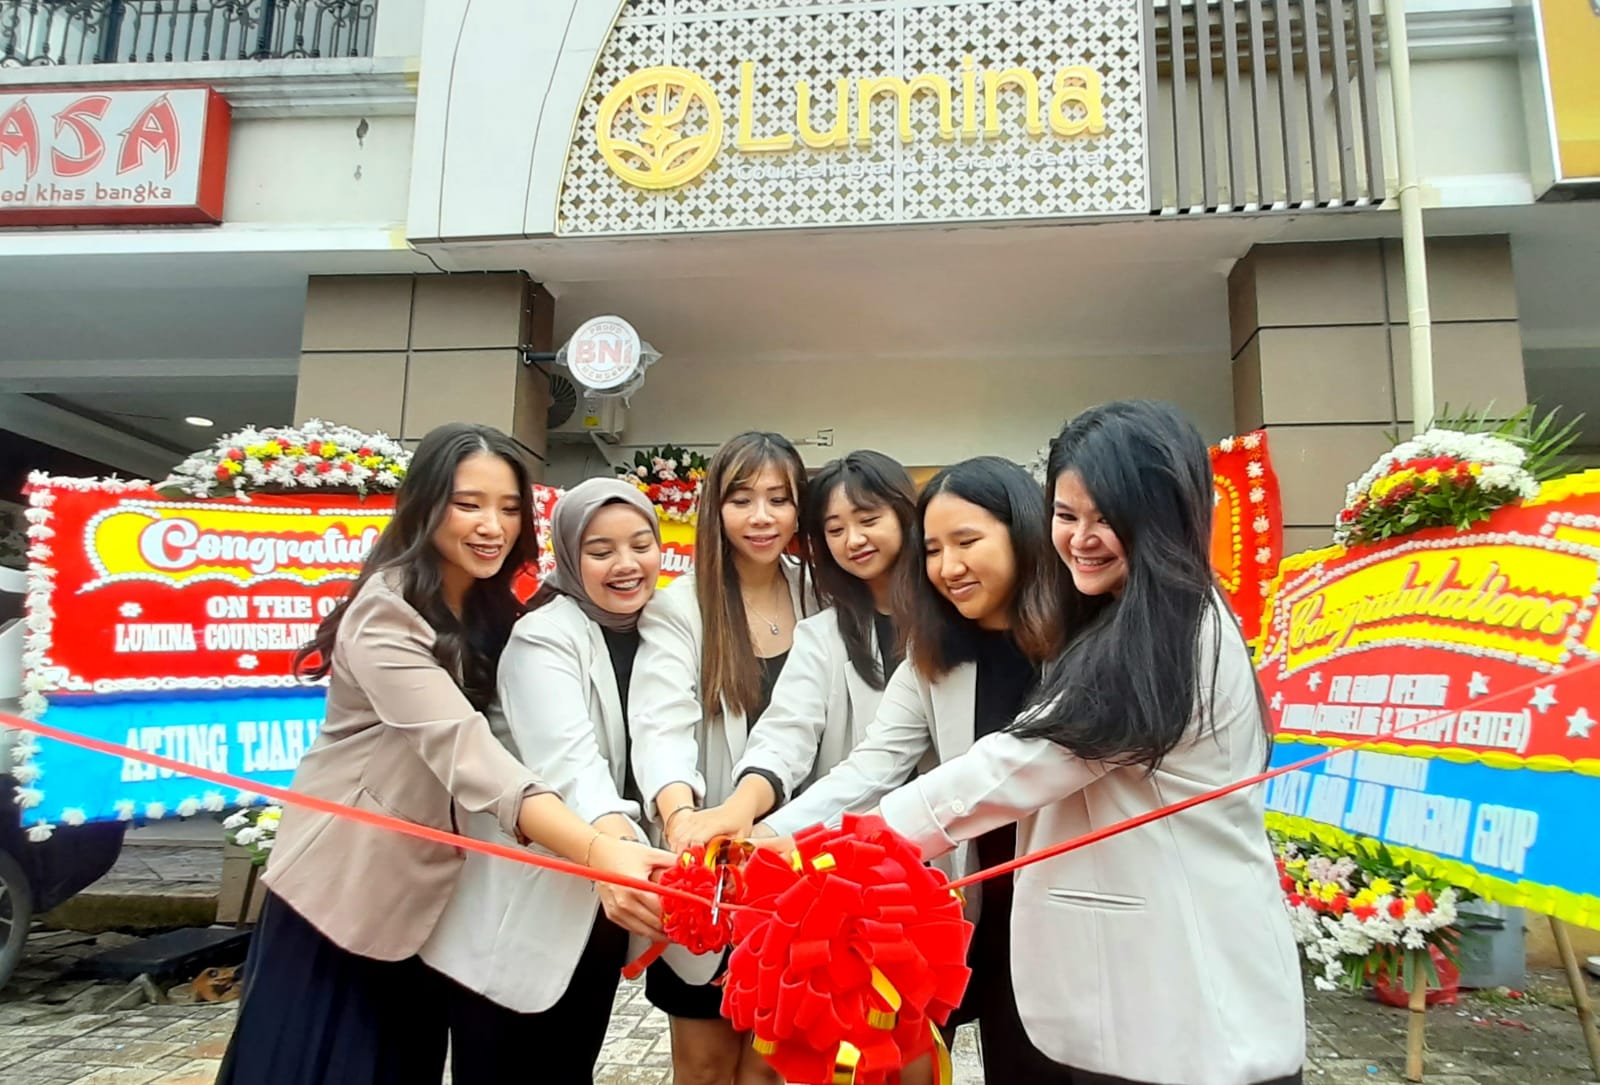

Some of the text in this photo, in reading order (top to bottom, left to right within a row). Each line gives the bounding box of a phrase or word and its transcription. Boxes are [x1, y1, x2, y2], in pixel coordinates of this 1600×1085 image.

[737, 55, 1107, 153] Lumina
[36, 183, 86, 202] khas
[95, 181, 172, 203] bangka
[206, 596, 248, 618] ON
[253, 596, 313, 618] THE
[1288, 557, 1578, 648] Congratulations
[115, 624, 198, 652] LUMINA
